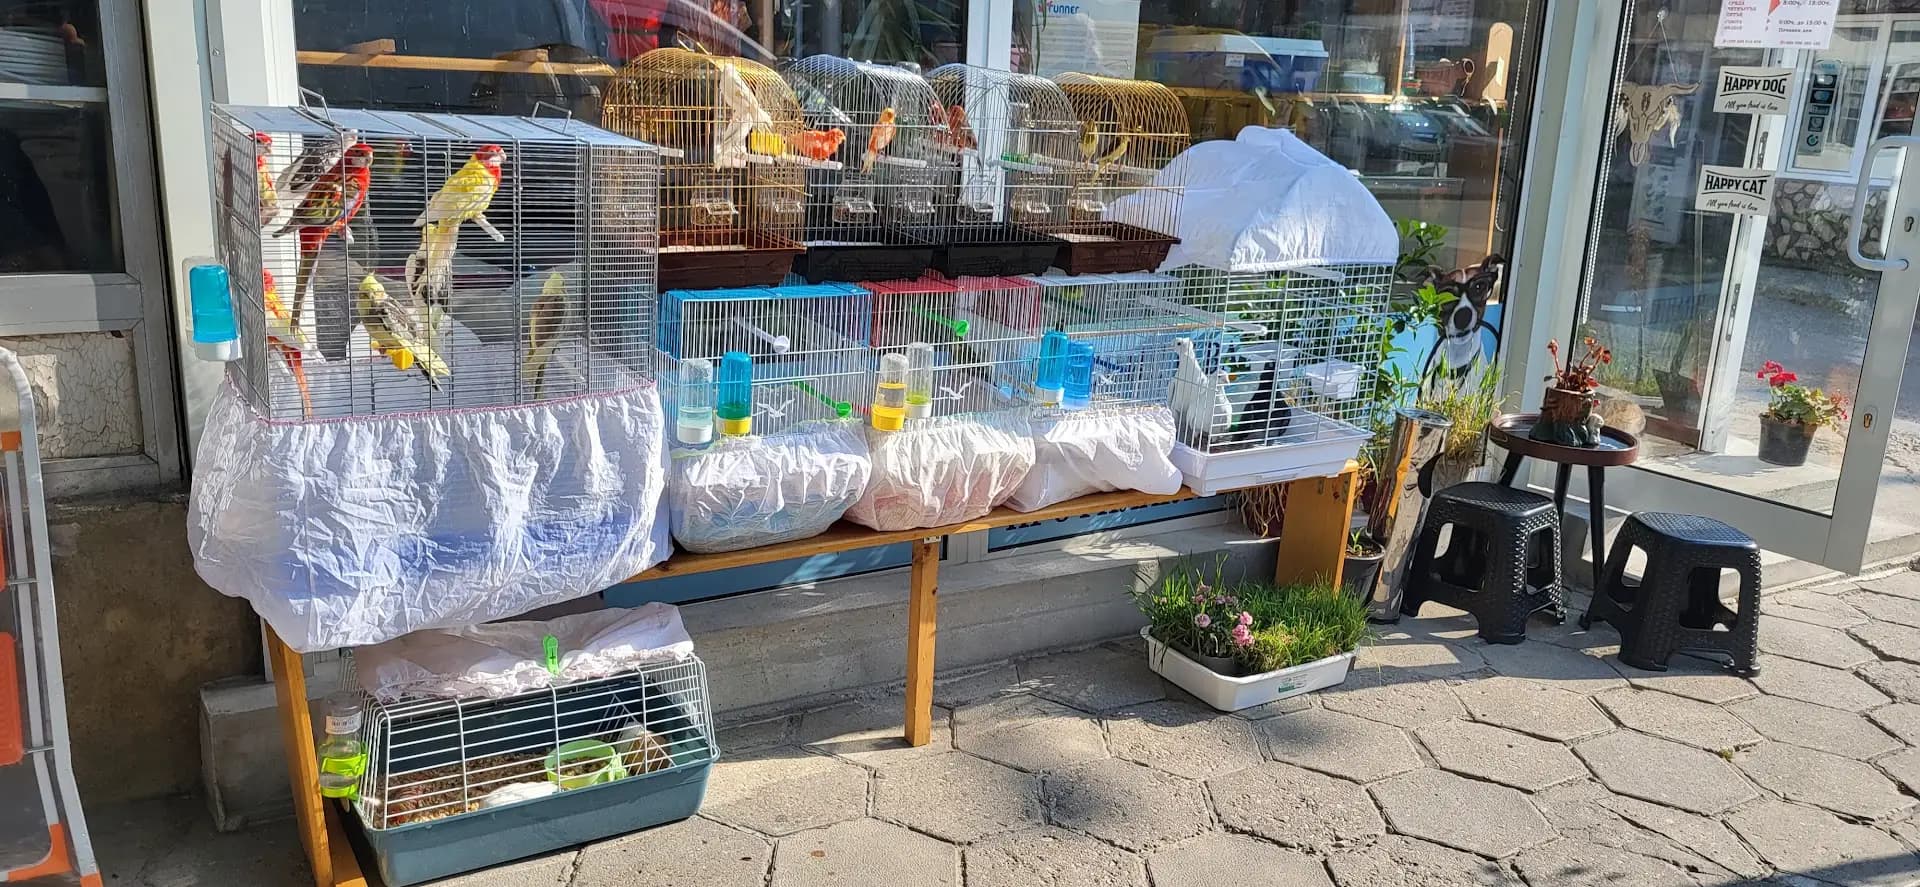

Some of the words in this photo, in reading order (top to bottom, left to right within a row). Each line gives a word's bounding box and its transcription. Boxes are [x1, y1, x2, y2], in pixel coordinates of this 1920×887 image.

[1722, 75, 1761, 92] HAPPY
[1762, 78, 1787, 94] DOG
[1704, 174, 1741, 190] HAPPY
[1743, 179, 1767, 195] CAT
